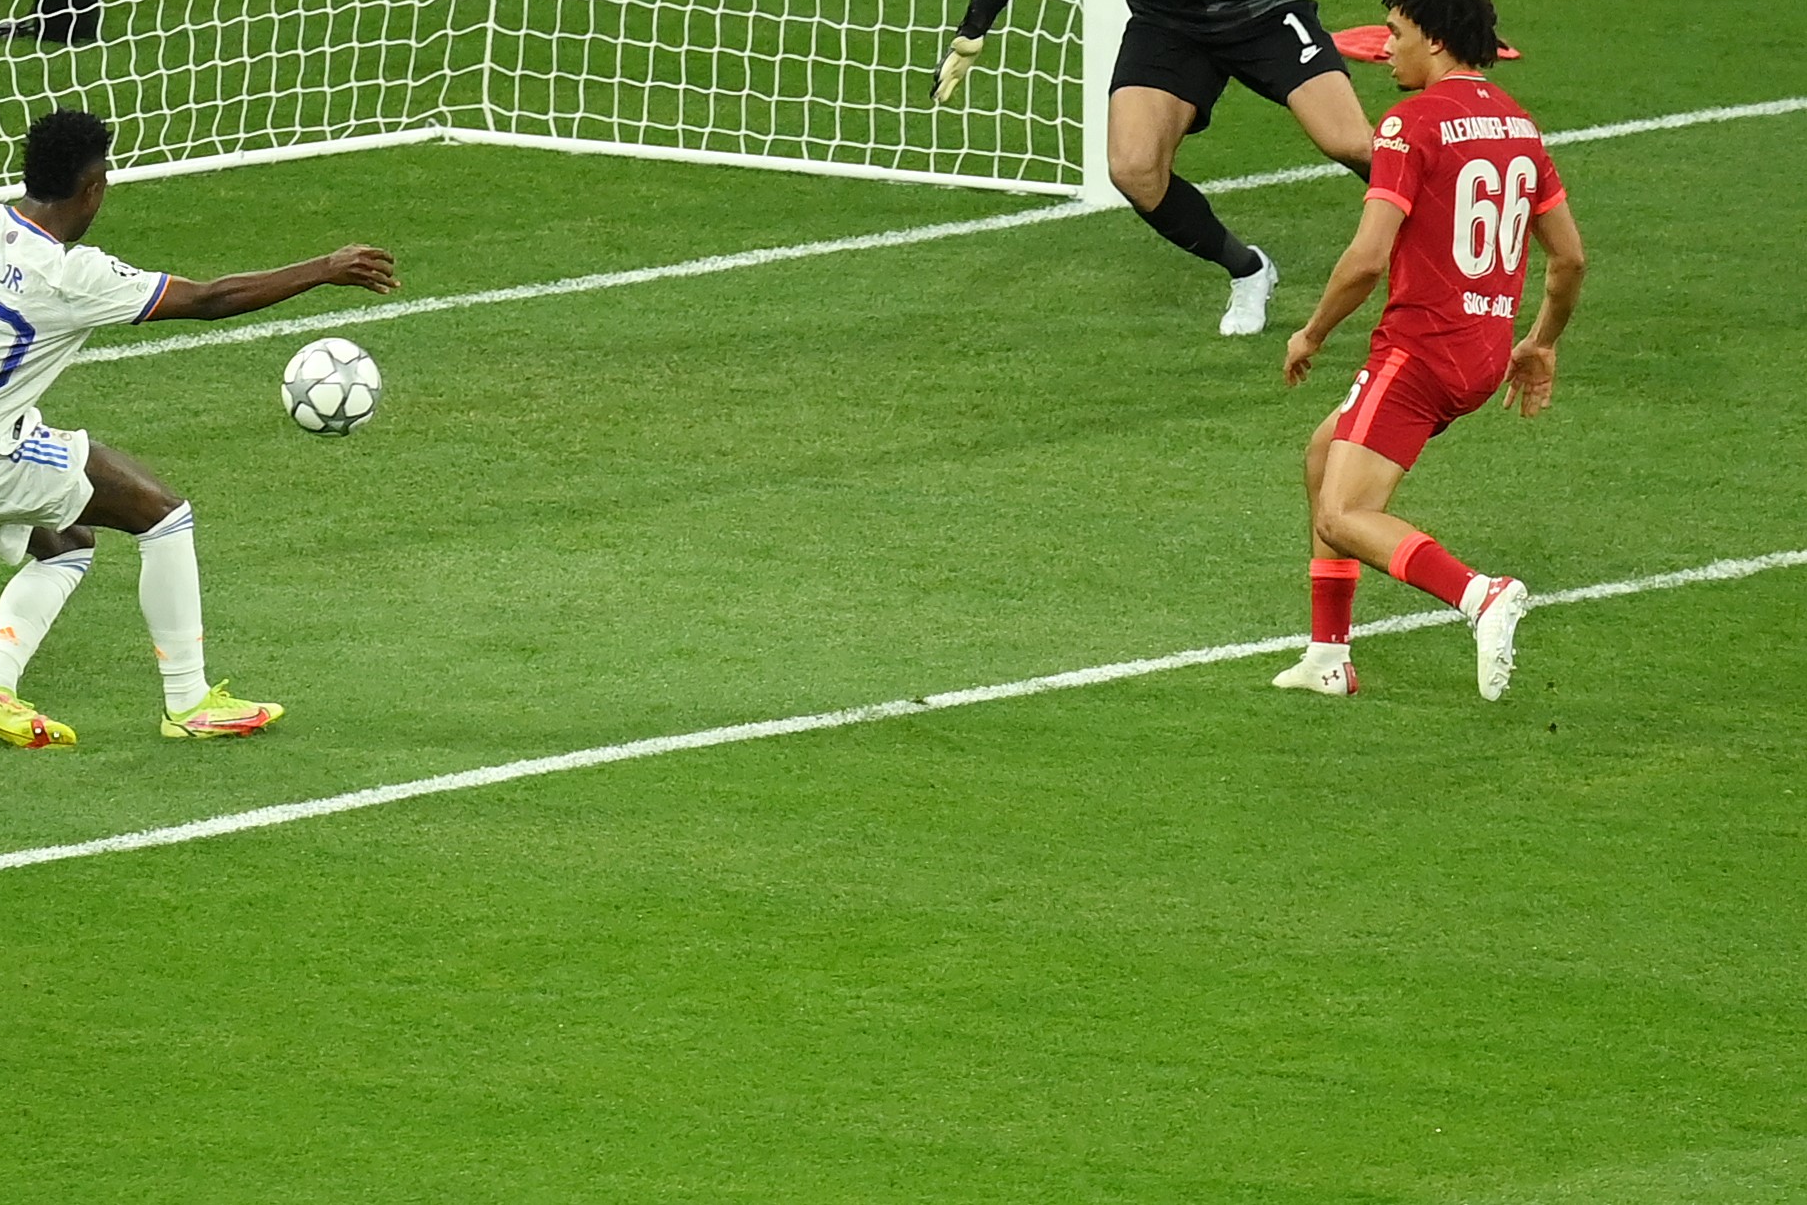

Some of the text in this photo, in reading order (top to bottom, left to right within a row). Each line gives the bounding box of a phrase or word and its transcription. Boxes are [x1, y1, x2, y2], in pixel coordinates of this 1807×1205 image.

[1283, 13, 1313, 45] 1
[1452, 155, 1538, 279] 66
[0, 264, 24, 294] JR.
